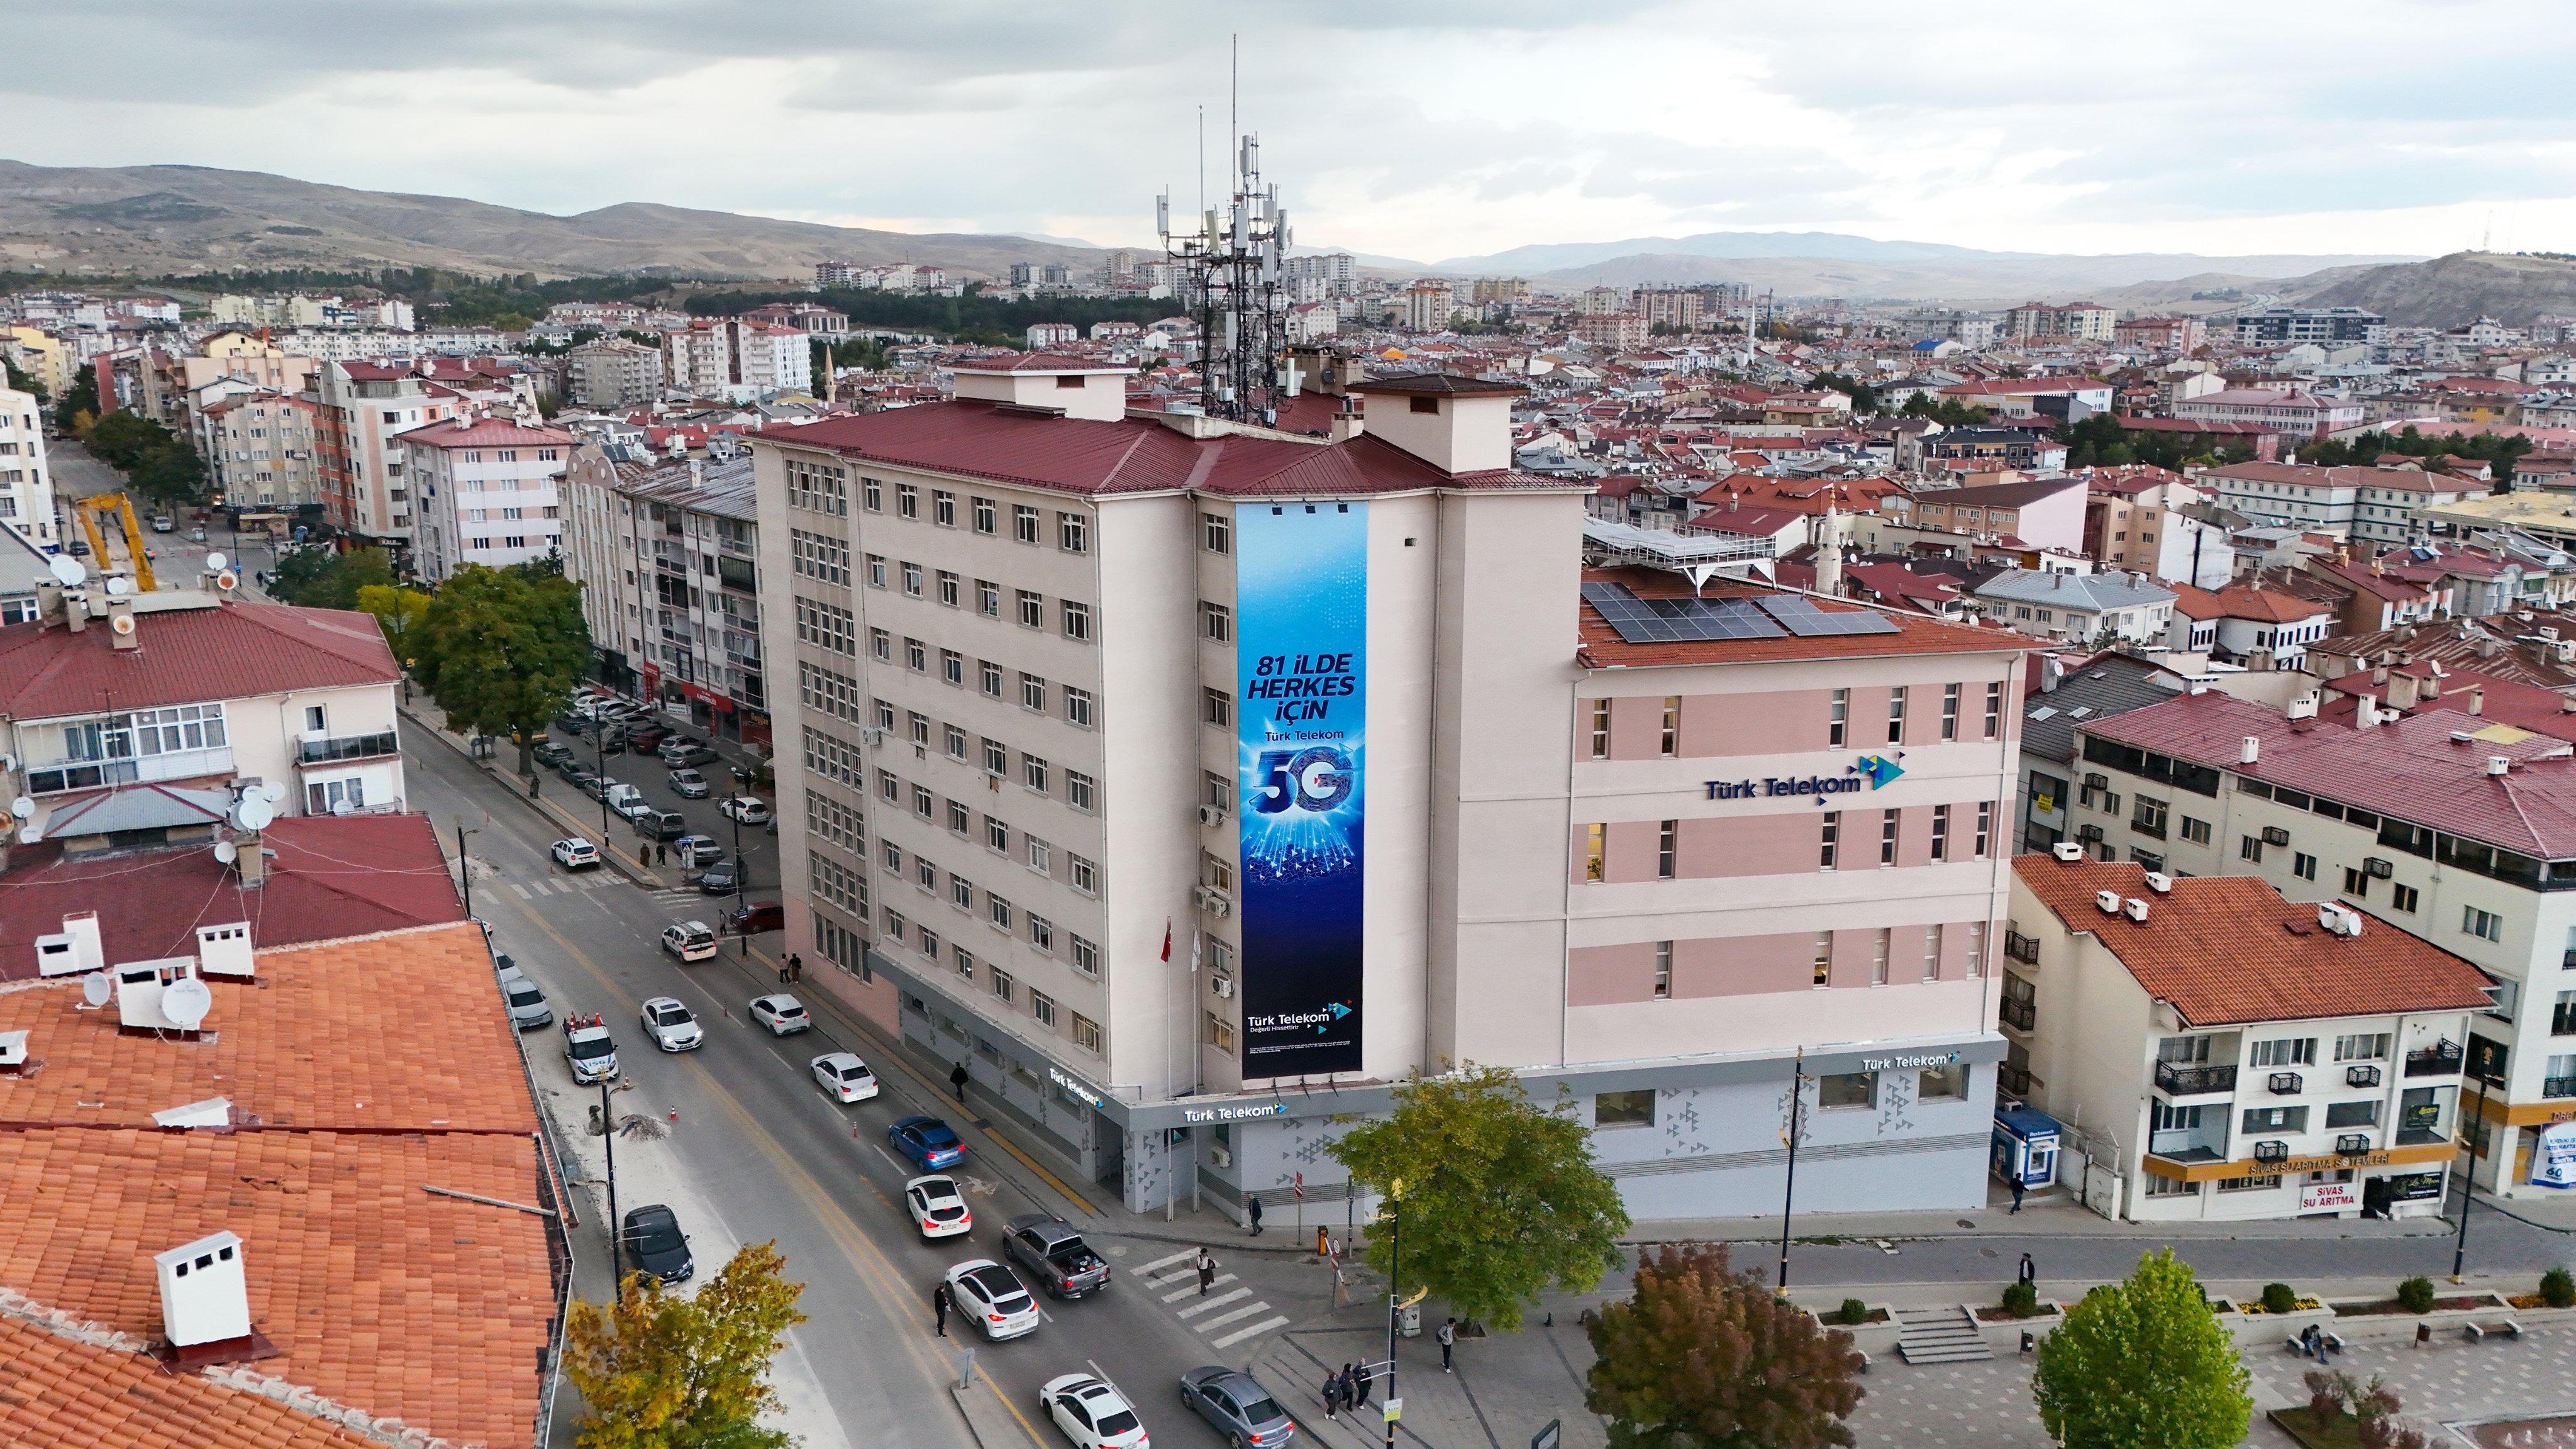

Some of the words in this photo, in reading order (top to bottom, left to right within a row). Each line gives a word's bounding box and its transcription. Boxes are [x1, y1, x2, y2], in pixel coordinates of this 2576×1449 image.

[1256, 655, 1285, 675] 81
[1247, 675, 1355, 699] HERKES
[1265, 731, 1291, 742] Türk
[1294, 729, 1344, 741] Telekom
[1248, 745, 1354, 814] 5G
[1705, 779, 1757, 800] Türk
[1764, 775, 1861, 797] Telekom
[1248, 1014, 1275, 1026] Türk
[1278, 1013, 1330, 1024] Telekom
[1862, 1058, 1891, 1070] Türk
[1894, 1055, 1947, 1068] Telekom
[1049, 1067, 1066, 1087] Türk
[1066, 1077, 1097, 1106] Telekom
[1184, 1109, 1214, 1123] Türk
[1217, 1105, 1274, 1119] Telekom
[2280, 1162, 2294, 1172] SU
[2296, 1159, 2331, 1171] ARITMA
[2334, 1153, 2390, 1169] SSTEMLERİ
[2546, 1167, 2562, 1177] 60
[2303, 1198, 2316, 1208] SU
[2319, 1196, 2355, 1207] ARITMA
